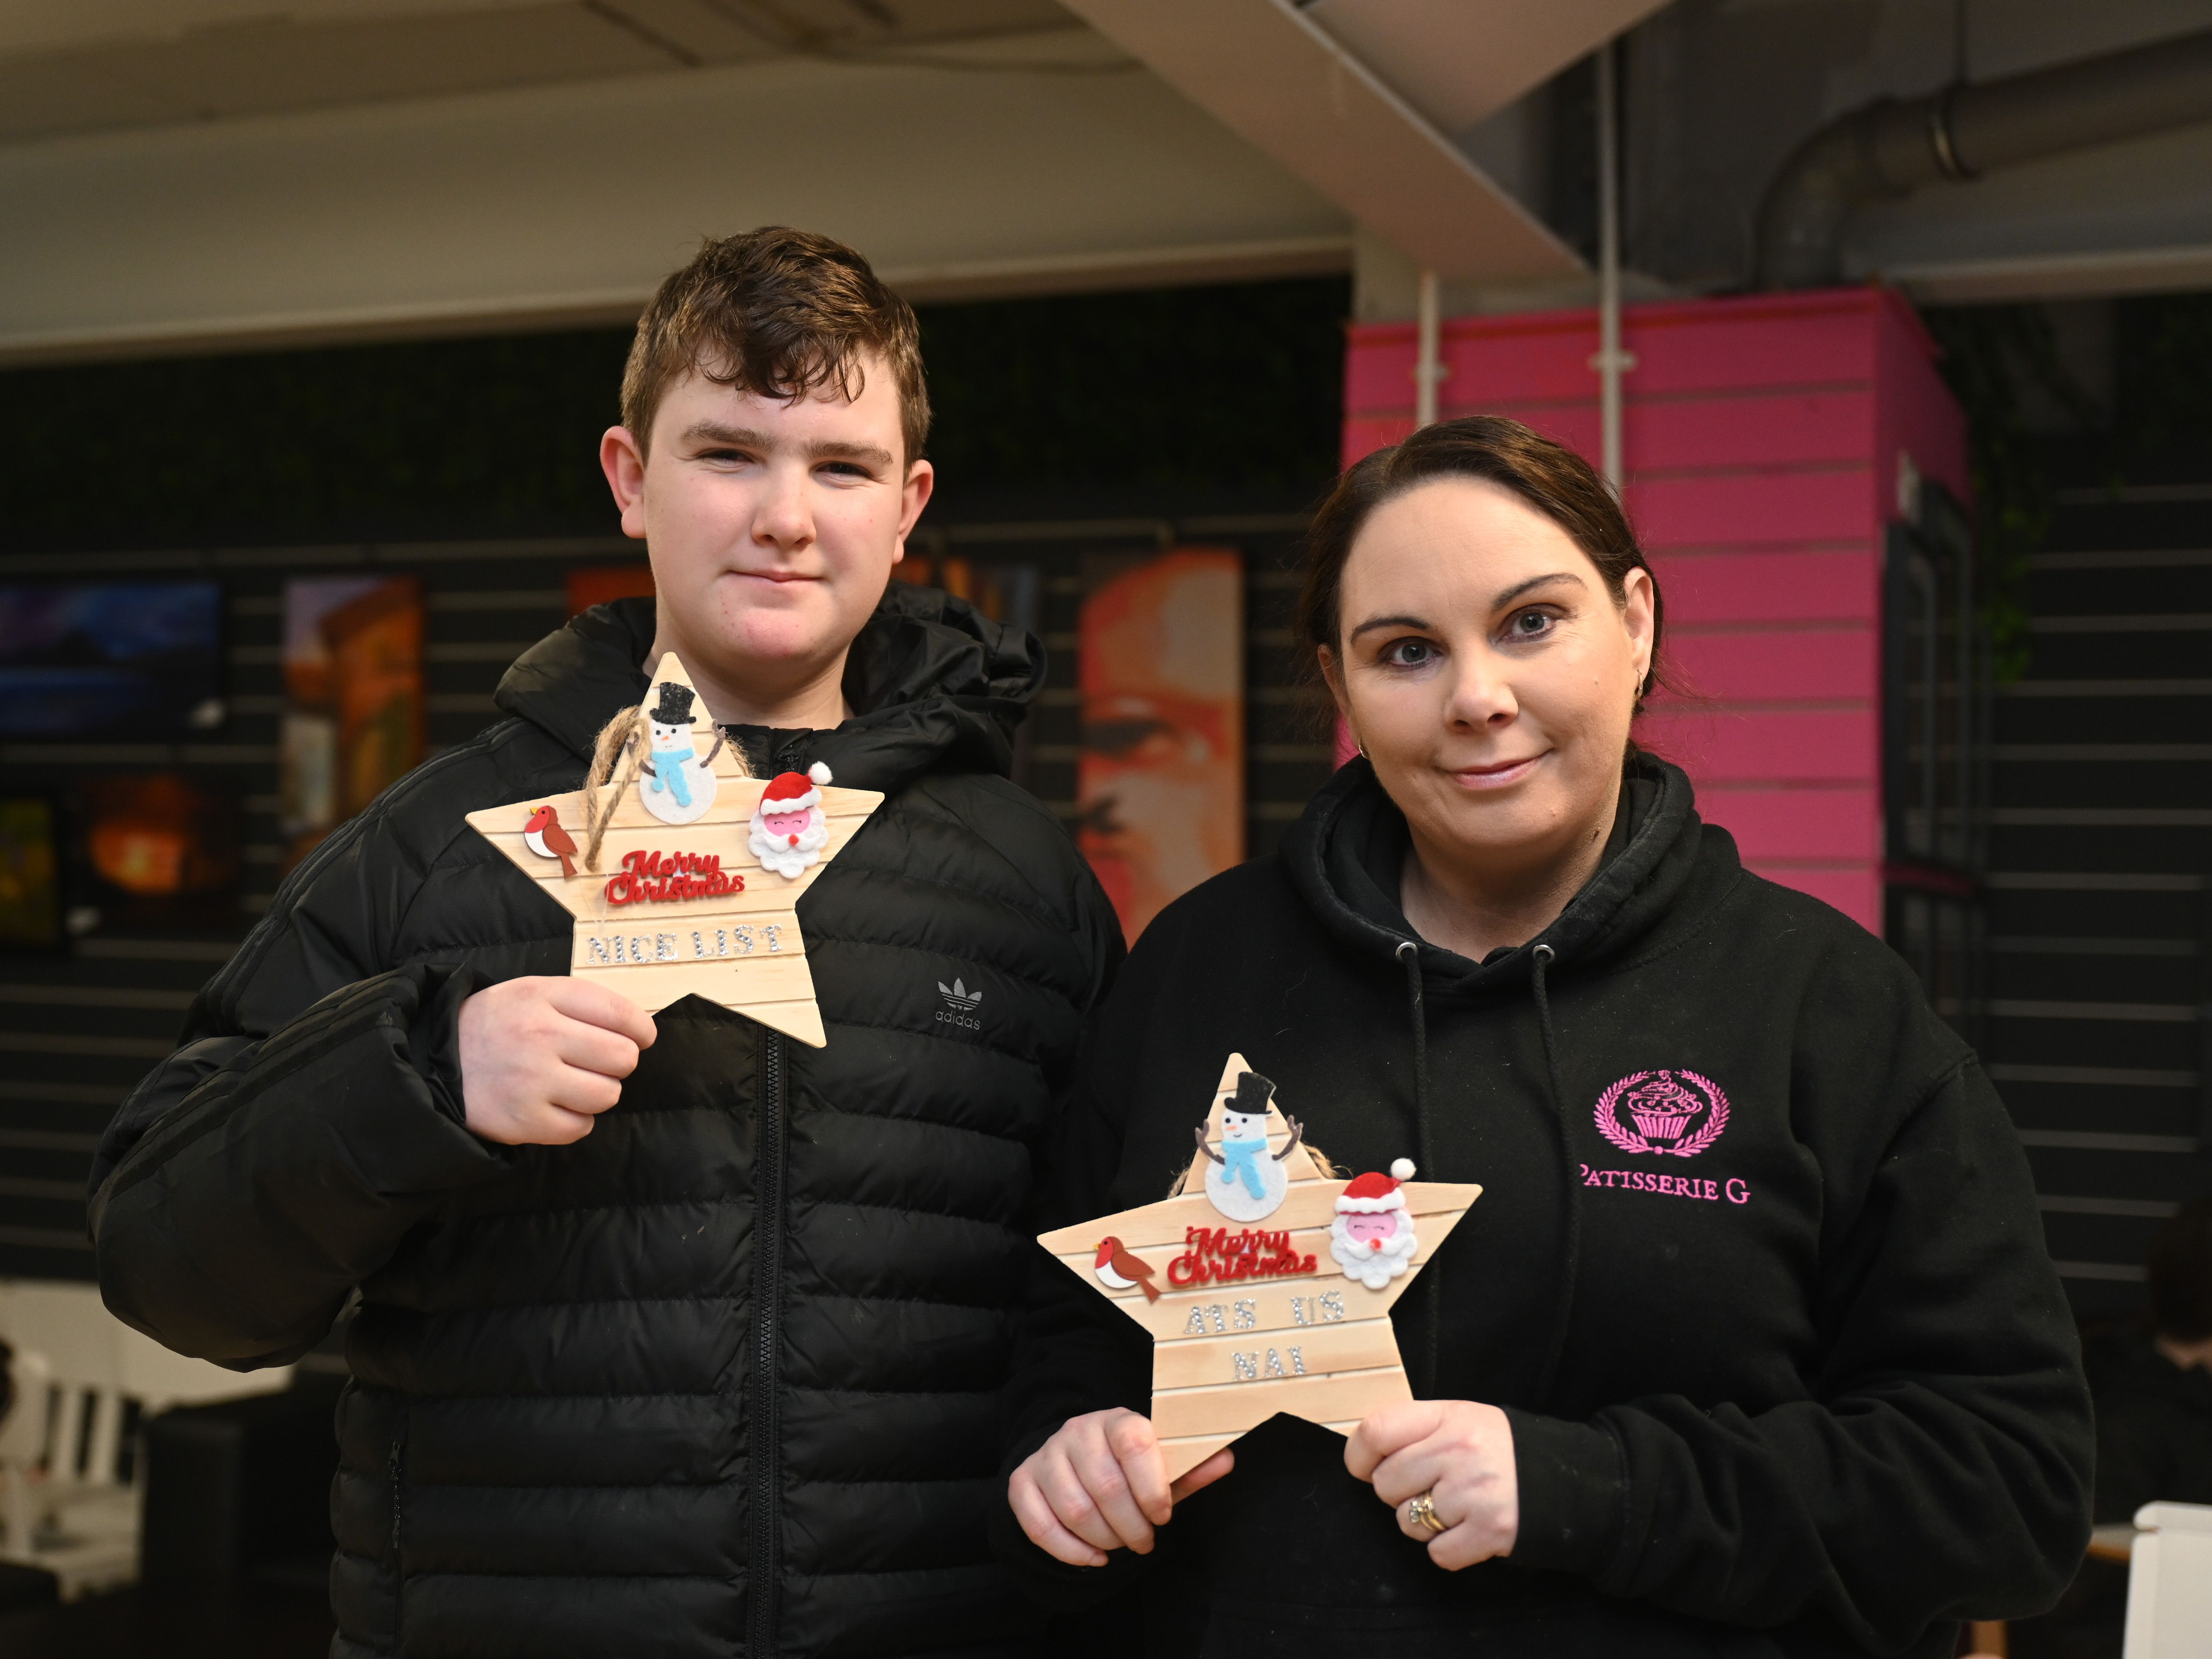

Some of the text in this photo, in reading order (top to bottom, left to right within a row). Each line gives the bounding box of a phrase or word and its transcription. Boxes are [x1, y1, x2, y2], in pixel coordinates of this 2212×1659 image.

[622, 850, 720, 881] Merry
[605, 871, 745, 904] Christmas
[586, 923, 783, 964] NICE LIST
[935, 1010, 981, 1030] adidas
[1725, 1178, 1751, 1204] G
[1186, 1226, 1290, 1258] Merry
[1167, 1250, 1317, 1285] Christmas
[1183, 1289, 1344, 1334] ATS US
[1232, 1345, 1307, 1381] NAI
